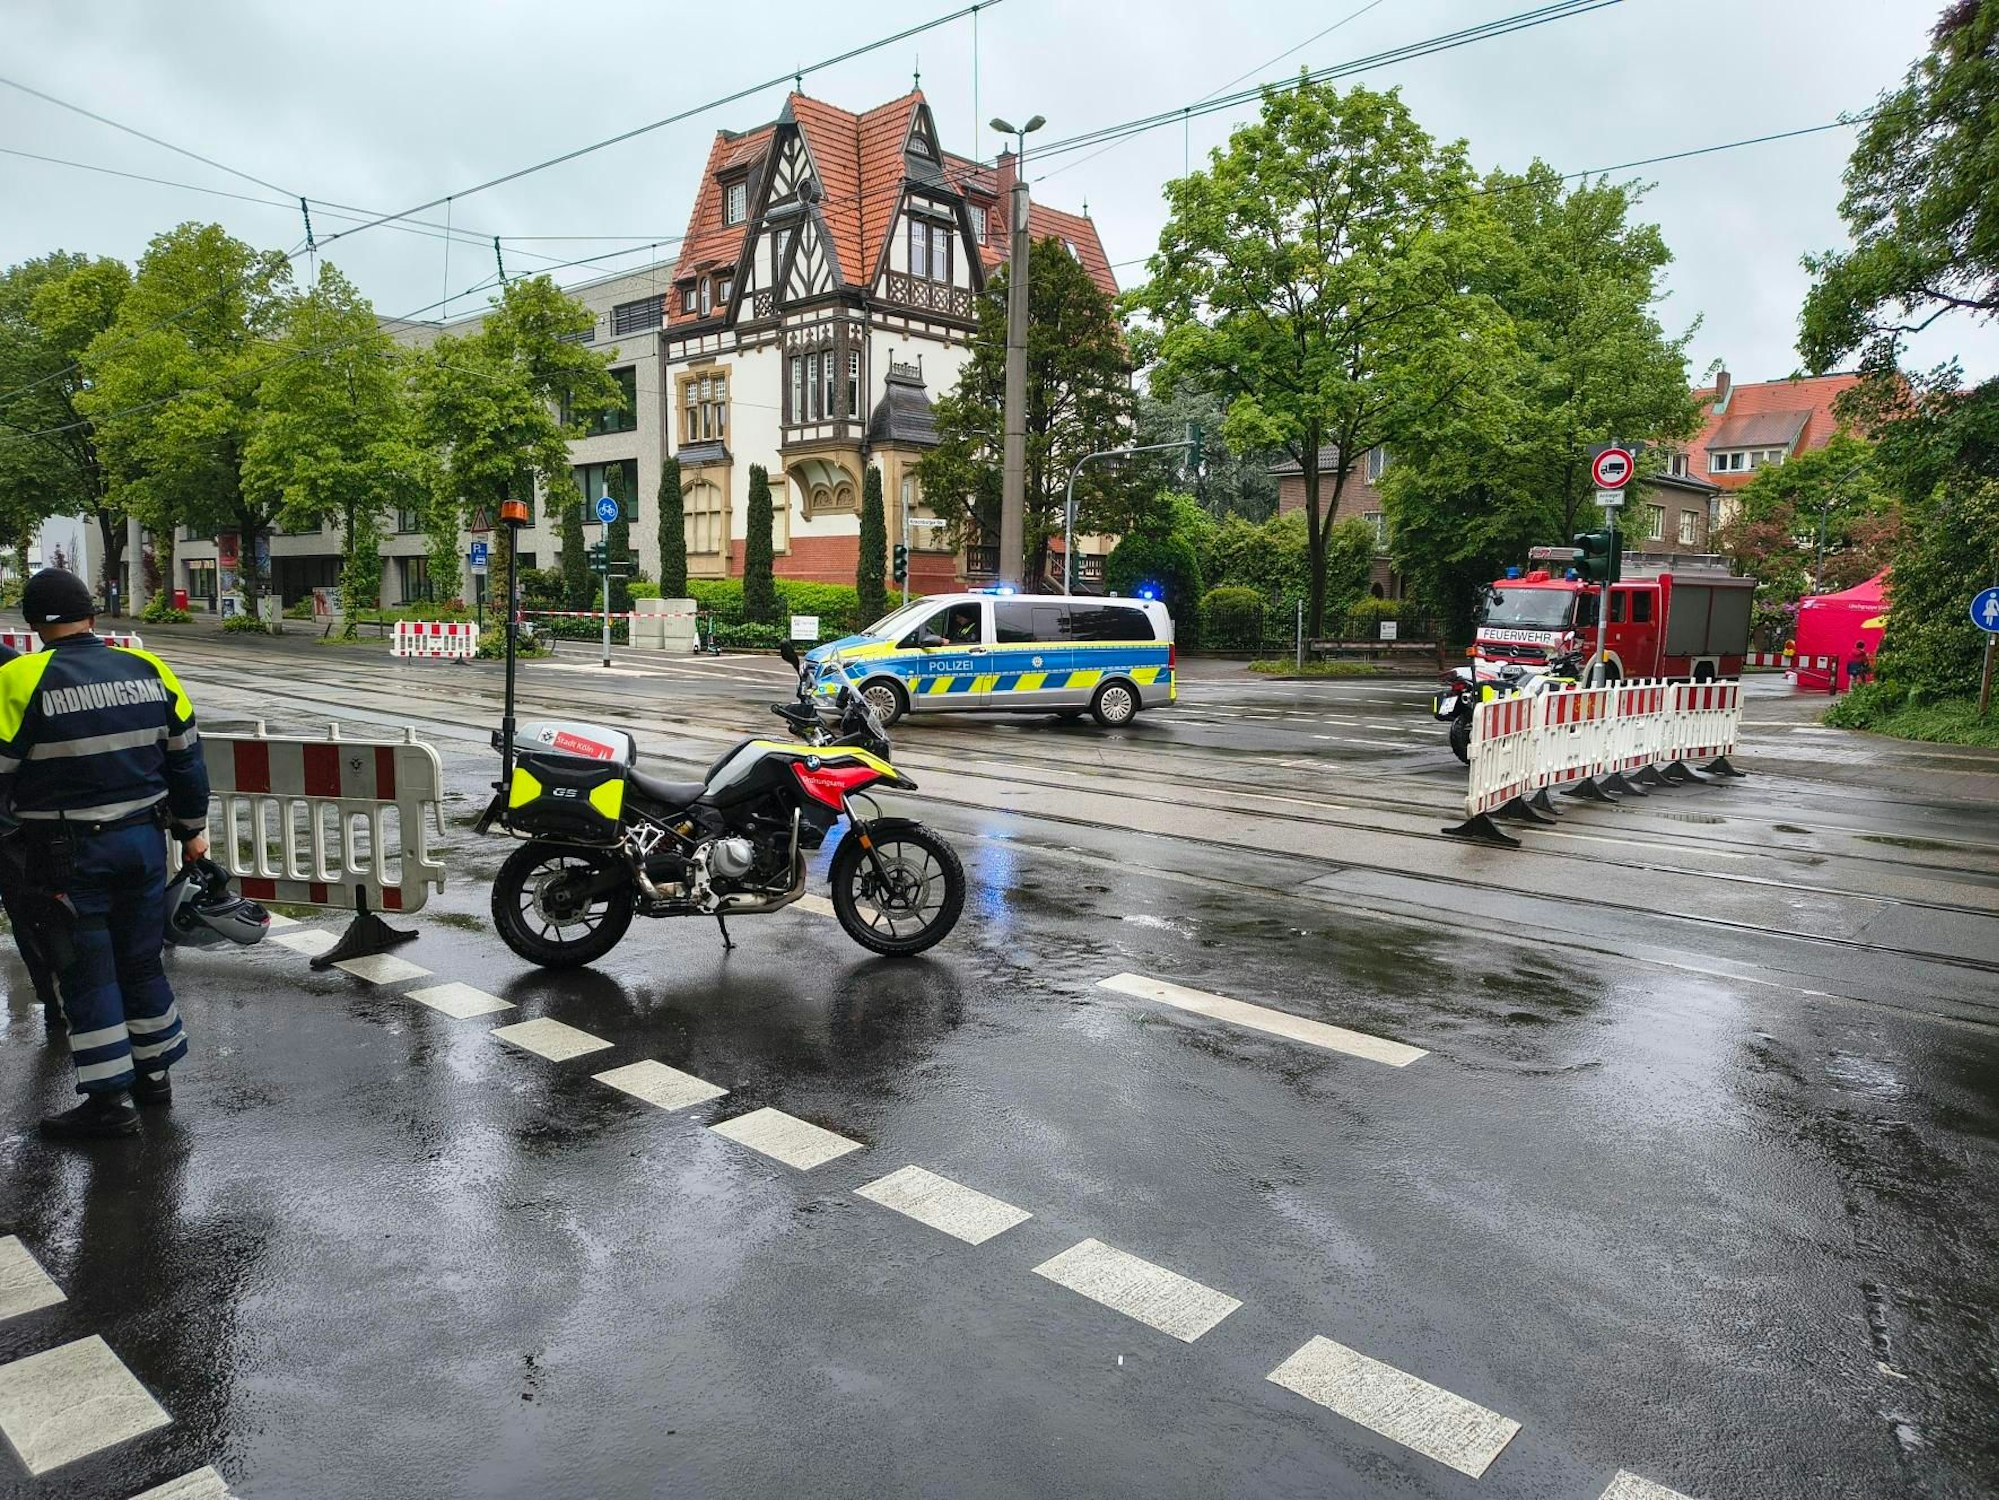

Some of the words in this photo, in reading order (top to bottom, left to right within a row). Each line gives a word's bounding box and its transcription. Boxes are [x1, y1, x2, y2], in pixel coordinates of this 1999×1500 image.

[473, 543, 481, 553] P
[1483, 628, 1552, 643] FEUERWEHR
[929, 660, 973, 671] POLIZEI
[42, 678, 168, 717] ORDNUNGSAMT
[556, 735, 576, 748] Stadt
[576, 742, 594, 753] Köln
[803, 776, 846, 788] Ordnungsamt
[552, 787, 578, 797] GS
